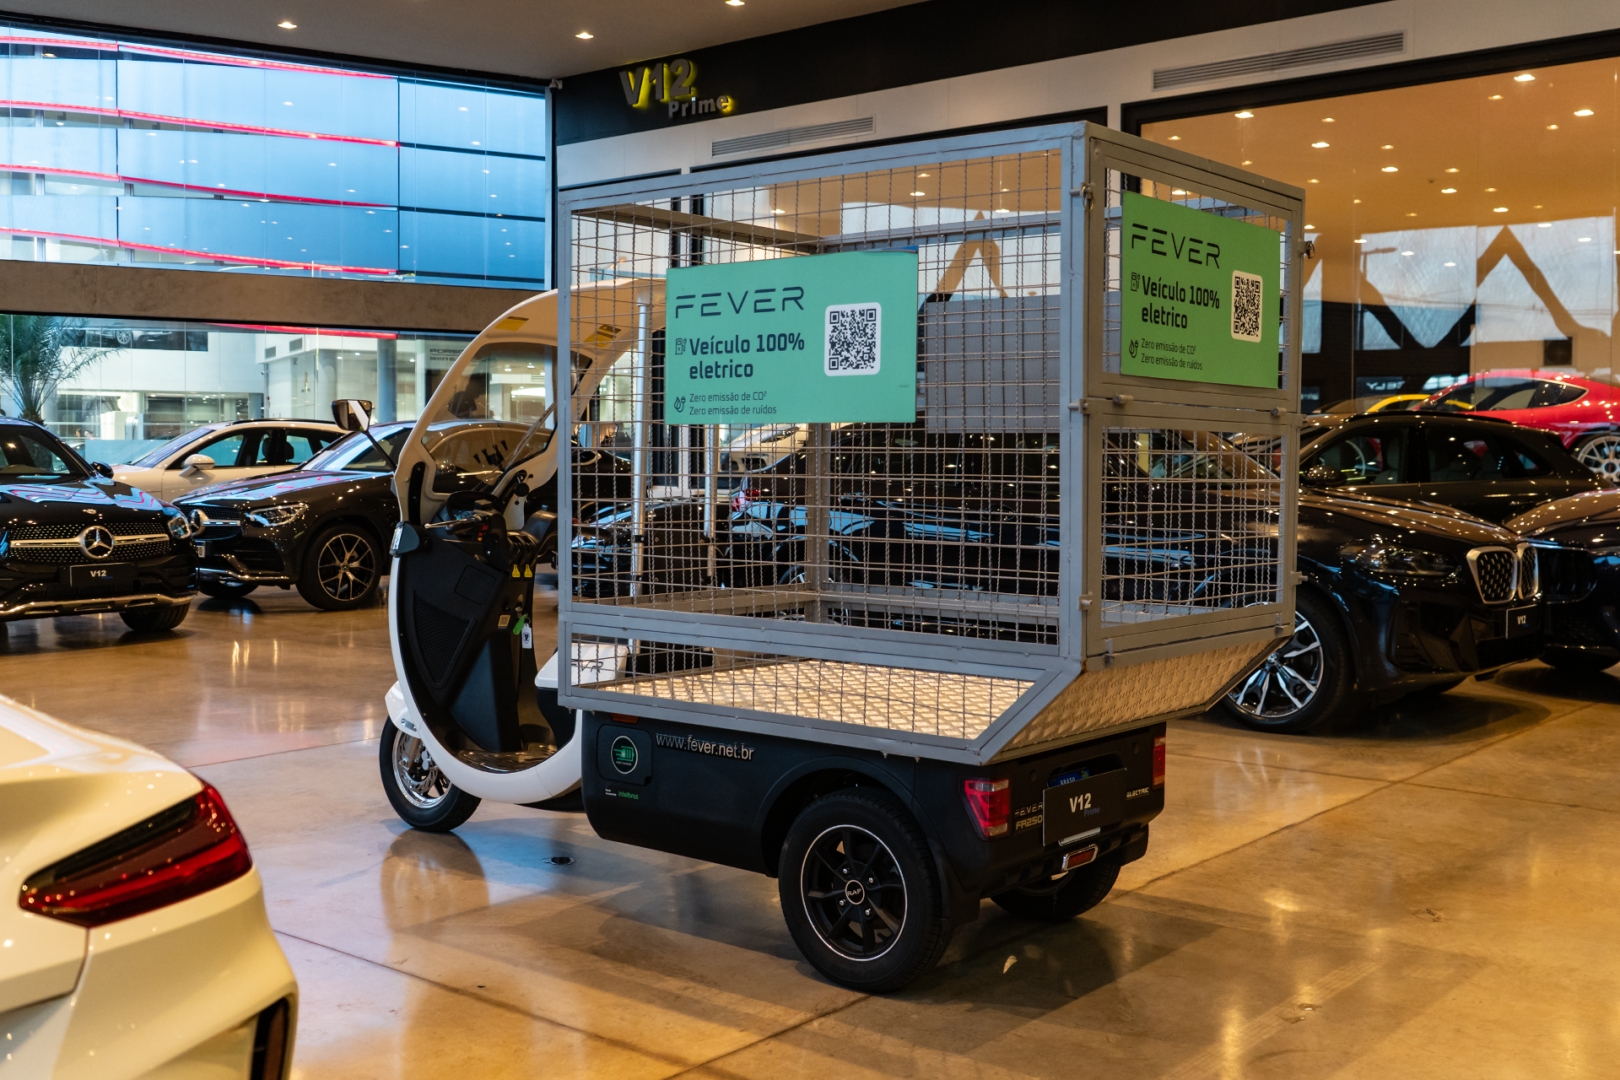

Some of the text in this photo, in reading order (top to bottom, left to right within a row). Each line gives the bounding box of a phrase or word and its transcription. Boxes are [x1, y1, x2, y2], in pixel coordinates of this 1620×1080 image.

[619, 59, 693, 106] V12
[668, 95, 729, 118] Prime
[1131, 223, 1220, 269] FEVER
[675, 286, 804, 318] FEVER
[1142, 276, 1220, 309] Veículo 100%
[1141, 302, 1188, 329] eletrico
[689, 332, 805, 355] Veículo 100%
[1141, 338, 1154, 349] Zero
[1156, 341, 1178, 353] emissão
[1179, 343, 1186, 354] de
[689, 359, 754, 379] eletrico
[1141, 353, 1203, 370] Zero emissão de ruídos
[689, 393, 706, 403] Zero
[708, 391, 739, 402] emissão
[741, 391, 751, 401] de
[689, 405, 777, 415] Zero emissão de ruídos
[655, 733, 755, 760] www.fever.net.br
[1069, 793, 1092, 813] V12
[1126, 787, 1149, 798] ELECTRIC
[1083, 806, 1101, 817] Prime
